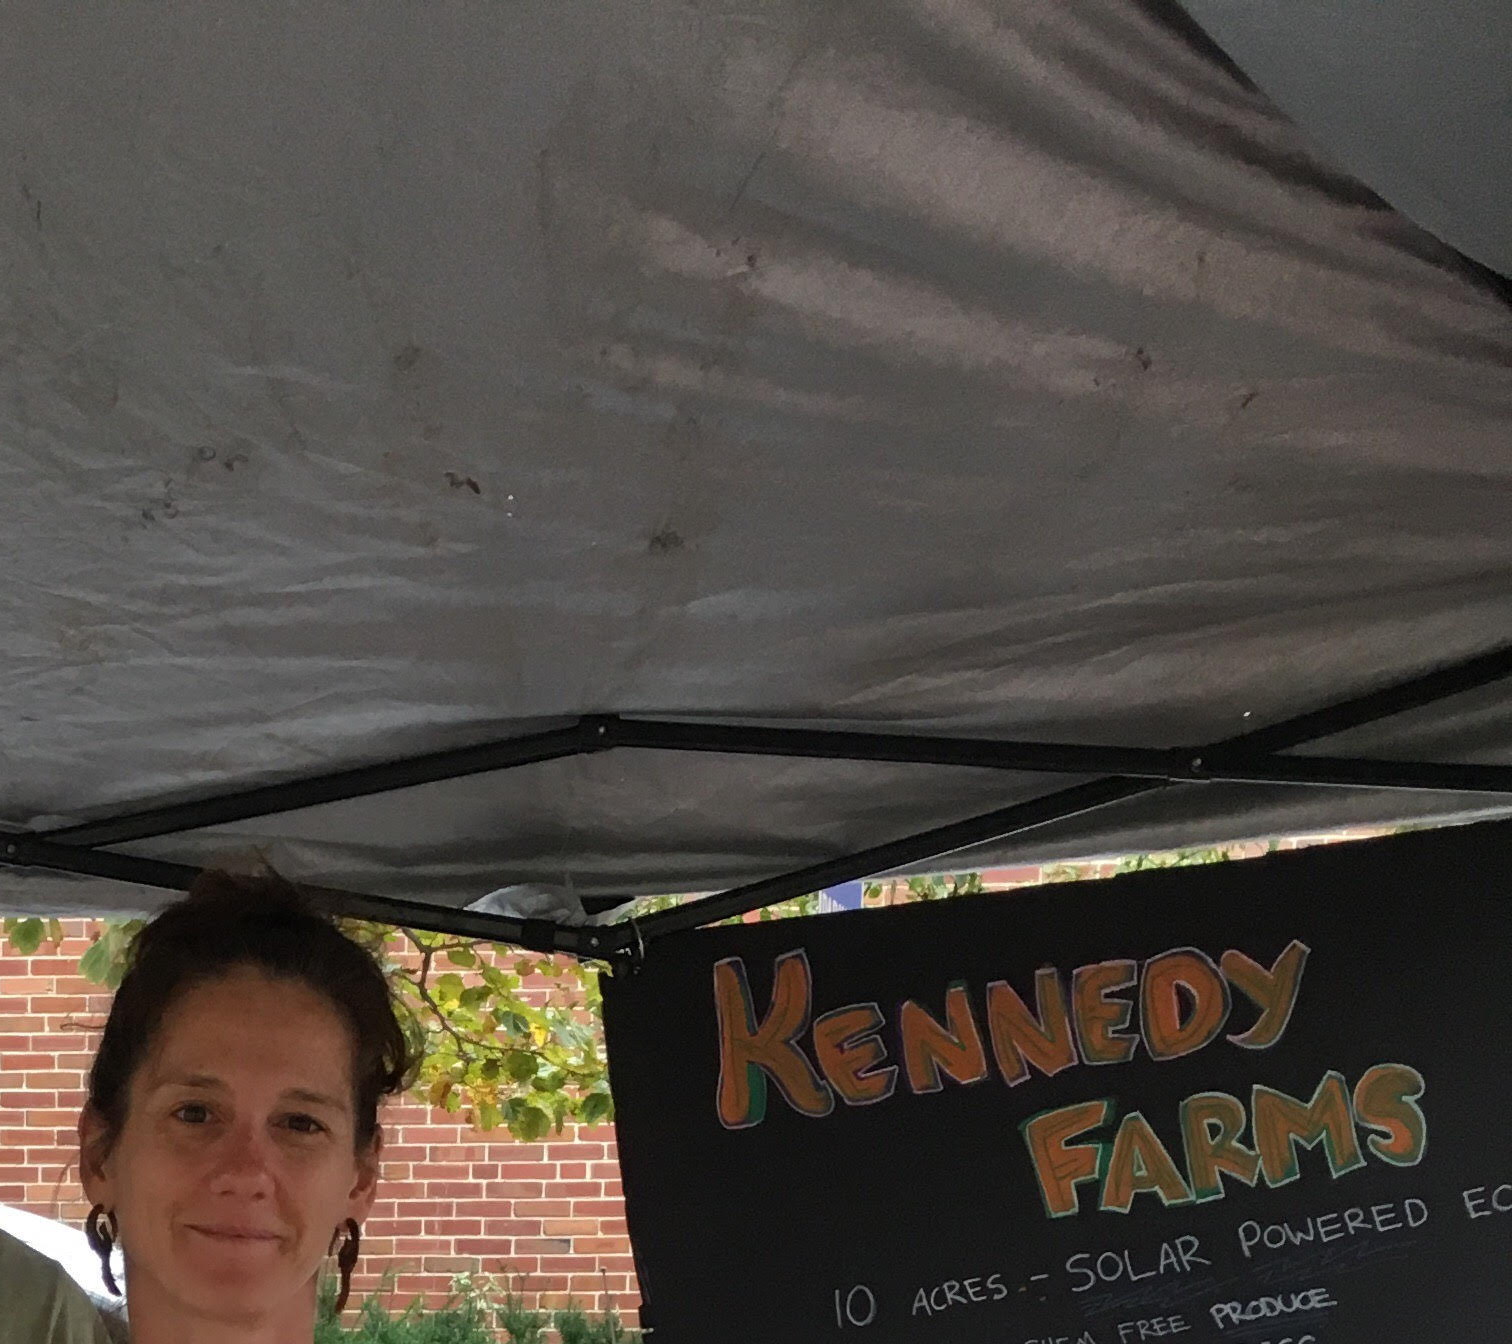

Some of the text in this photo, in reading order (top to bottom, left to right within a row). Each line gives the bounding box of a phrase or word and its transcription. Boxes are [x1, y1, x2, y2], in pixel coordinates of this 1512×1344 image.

[1020, 1063, 1428, 1218] FARMS
[834, 1284, 877, 1329] 10
[911, 1273, 1008, 1316] ACRES
[1065, 1234, 1212, 1292] SOLAR
[1238, 1198, 1429, 1257] POWERED
[1117, 1315, 1191, 1344] FREE
[1209, 1287, 1338, 1329] PRODUCE
